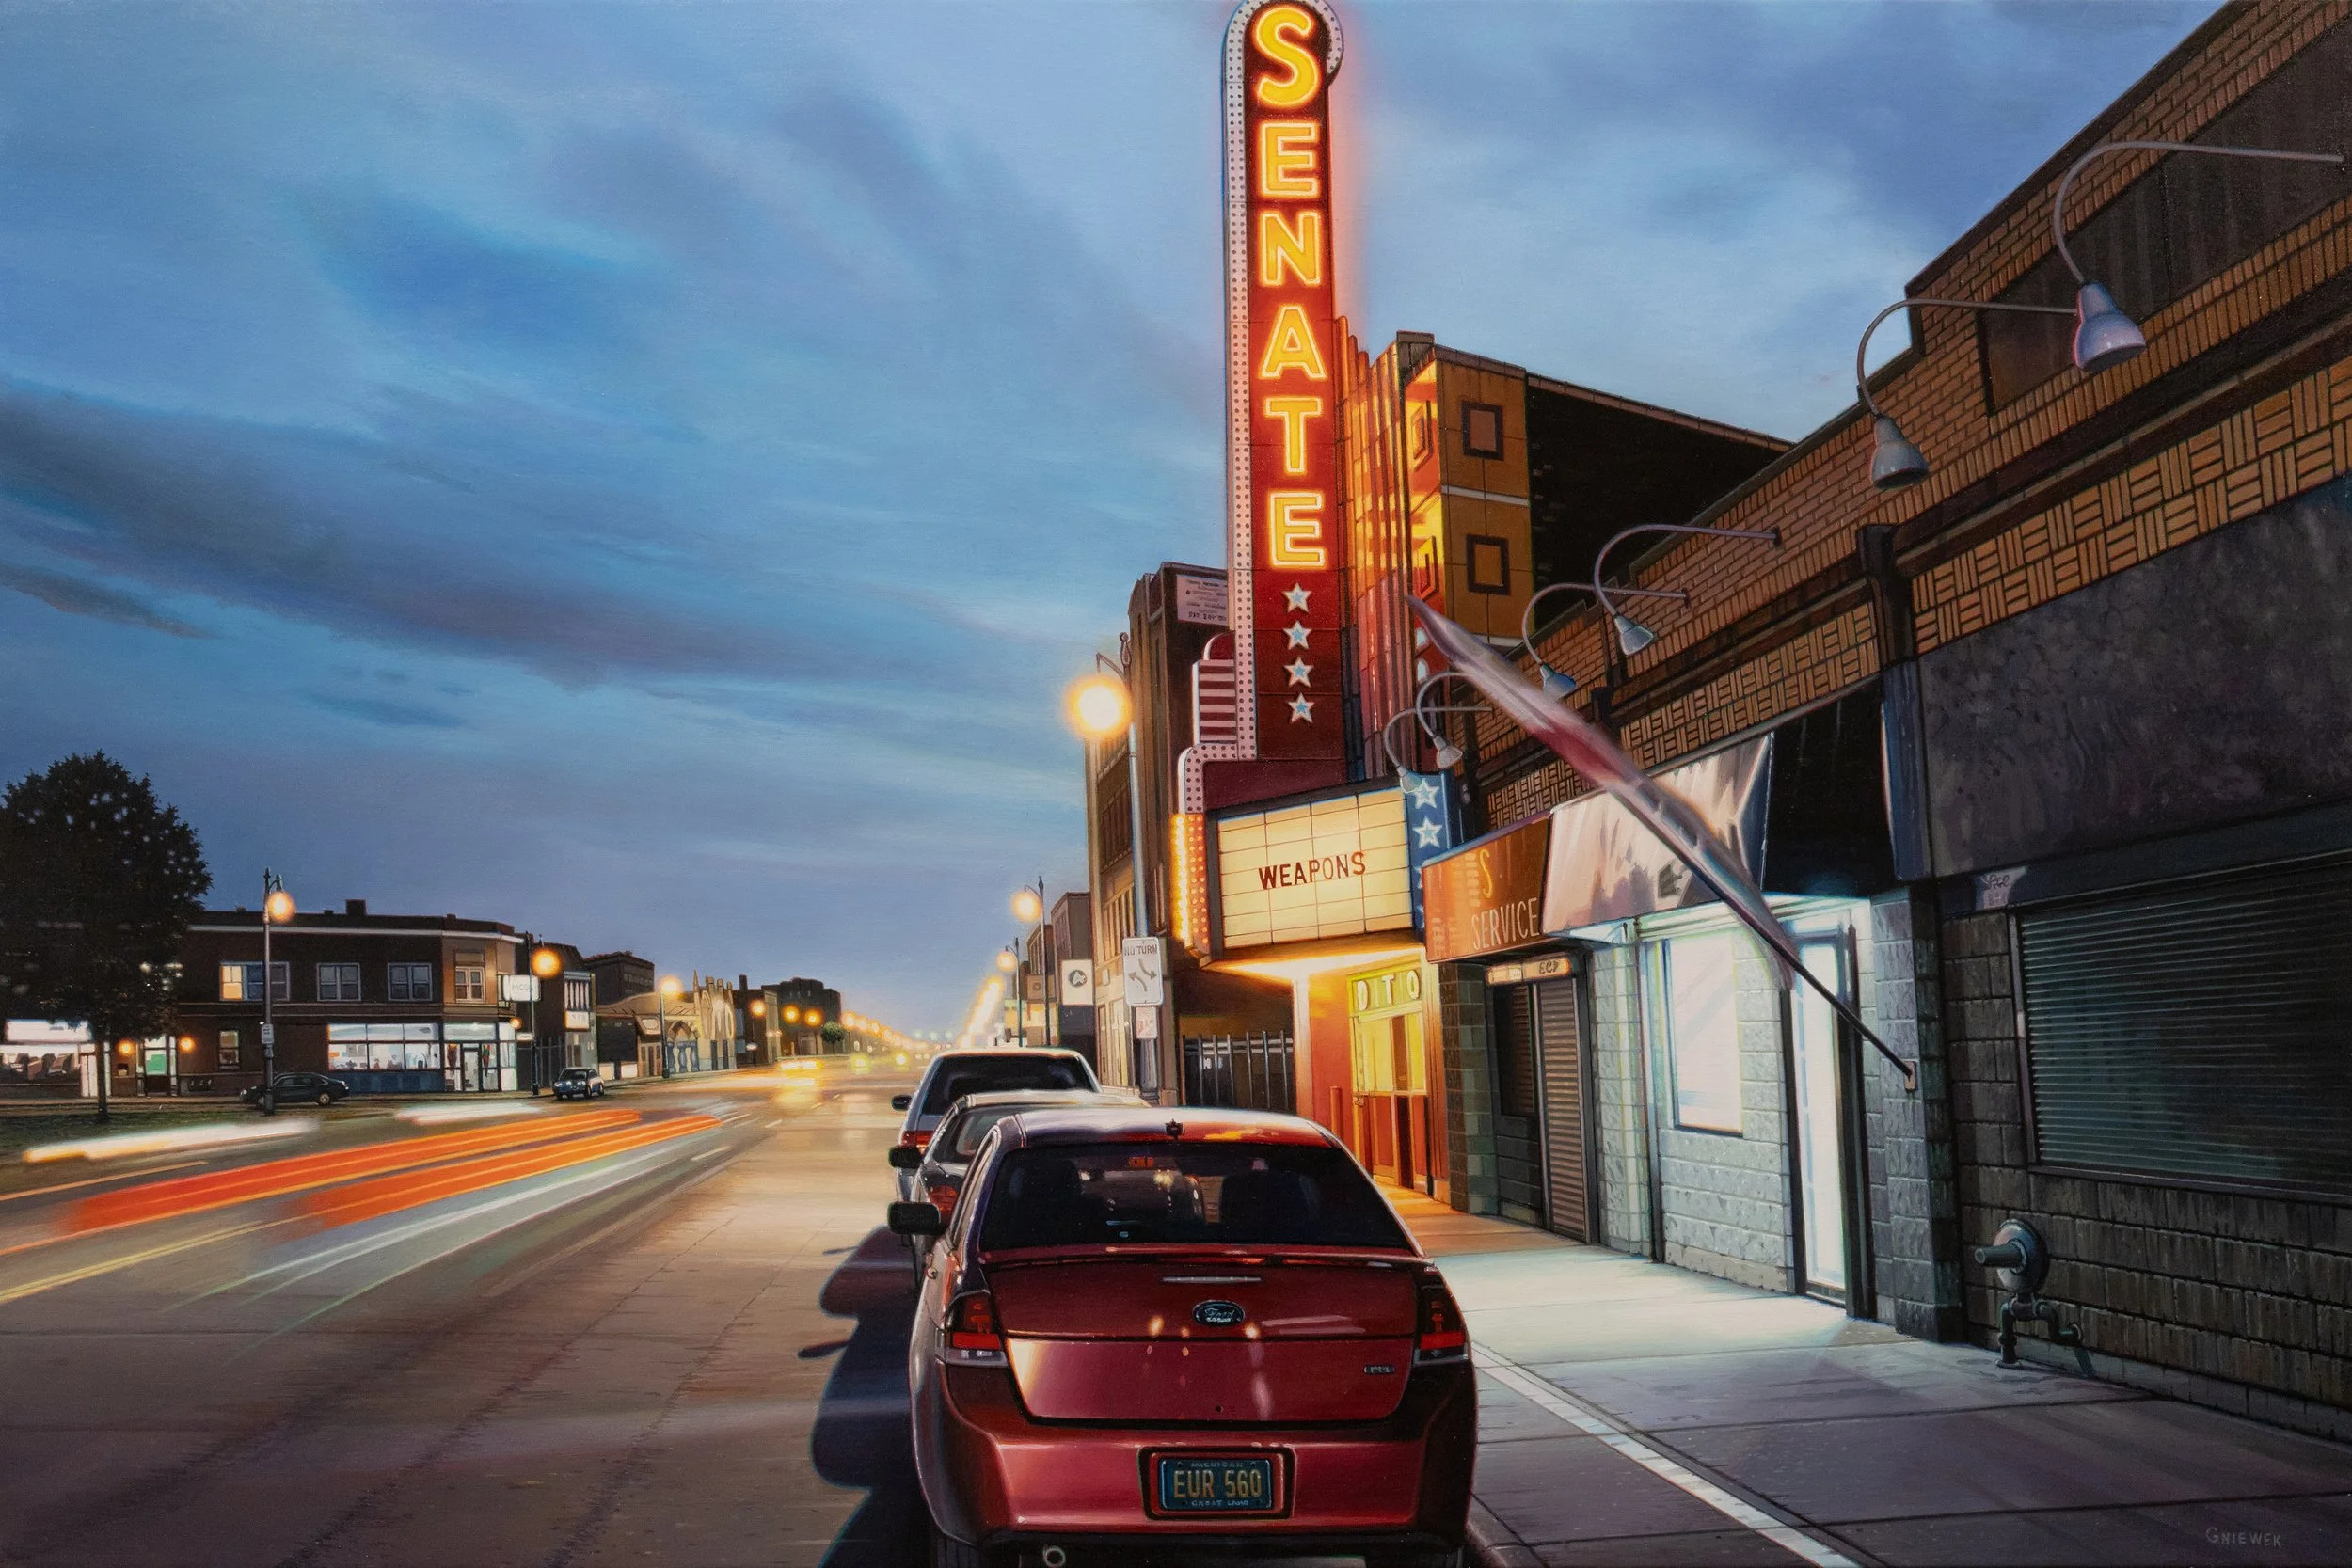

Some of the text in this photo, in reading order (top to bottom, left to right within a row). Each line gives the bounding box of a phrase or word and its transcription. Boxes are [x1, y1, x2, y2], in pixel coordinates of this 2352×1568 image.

[1255, 7, 1327, 566] SENATE
[1258, 851, 1366, 890] WEAPONS
[1479, 849, 1493, 899] S
[1471, 897, 1540, 950] SERVICE
[1136, 944, 1158, 955] TURN
[1174, 1469, 1263, 1498] EUR 560
